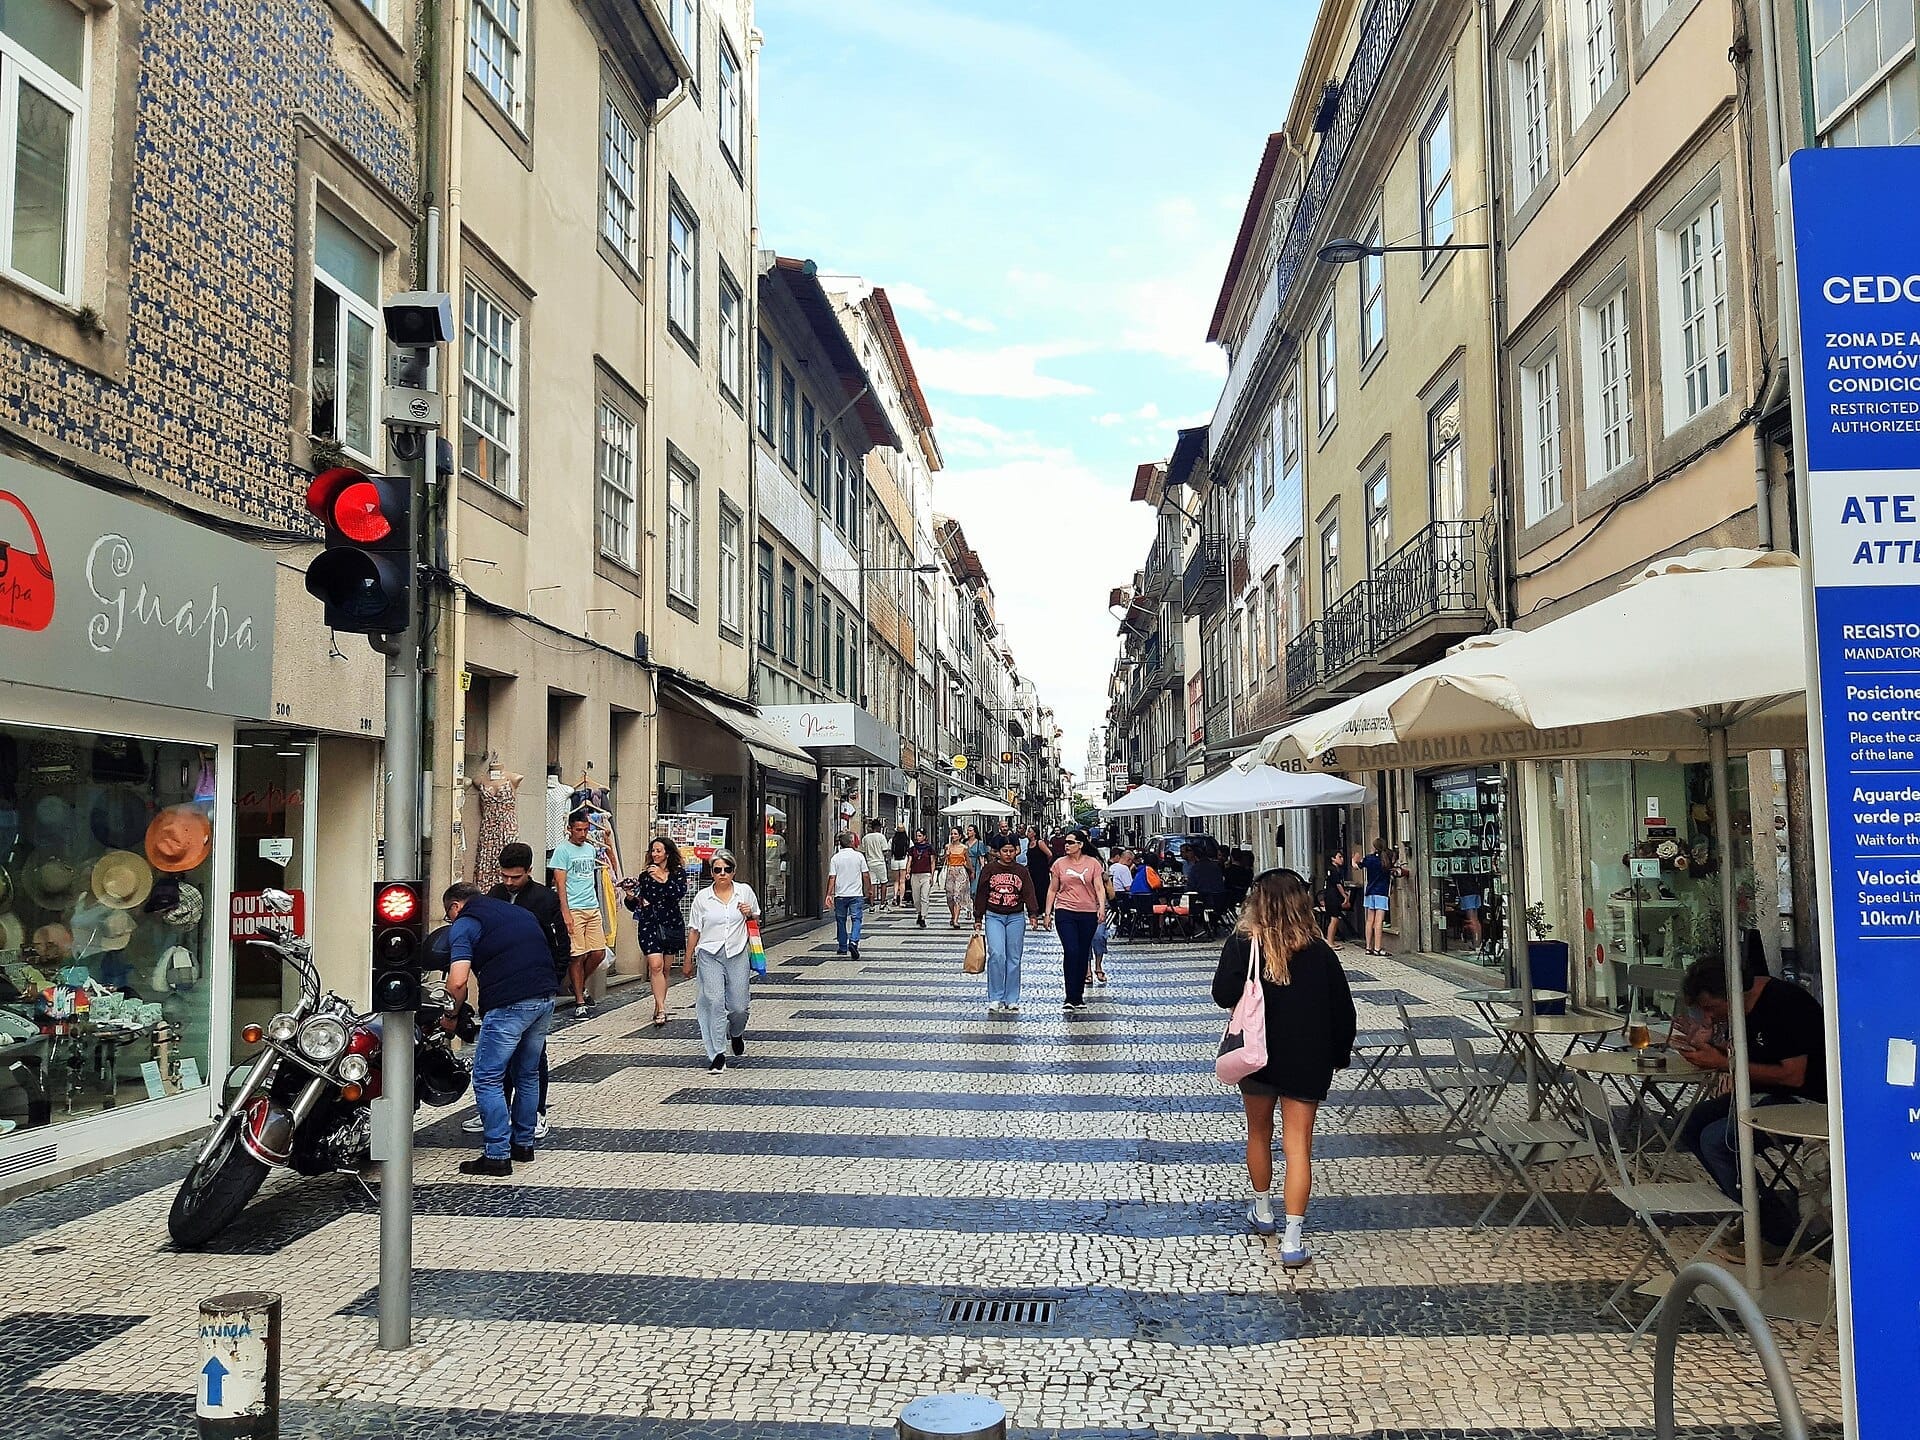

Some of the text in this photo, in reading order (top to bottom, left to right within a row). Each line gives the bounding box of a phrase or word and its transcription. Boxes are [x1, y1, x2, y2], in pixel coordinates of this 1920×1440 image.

[1825, 333, 1877, 347] ZONA
[1881, 333, 1906, 346] DE
[1830, 402, 1918, 415] RESTRICTED
[1841, 495, 1916, 523] ATE
[86, 533, 259, 691] Guapa
[1843, 624, 1920, 639] REGISTO
[1848, 711, 1868, 721] no
[1850, 731, 1883, 743] Place
[1885, 731, 1906, 743] the
[1851, 748, 1914, 760] of the lane
[1853, 787, 1920, 805] Aguarde
[1854, 809, 1899, 824] verde
[1856, 834, 1885, 846] Wait
[1886, 833, 1904, 845] for
[1858, 892, 1899, 905] Speed
